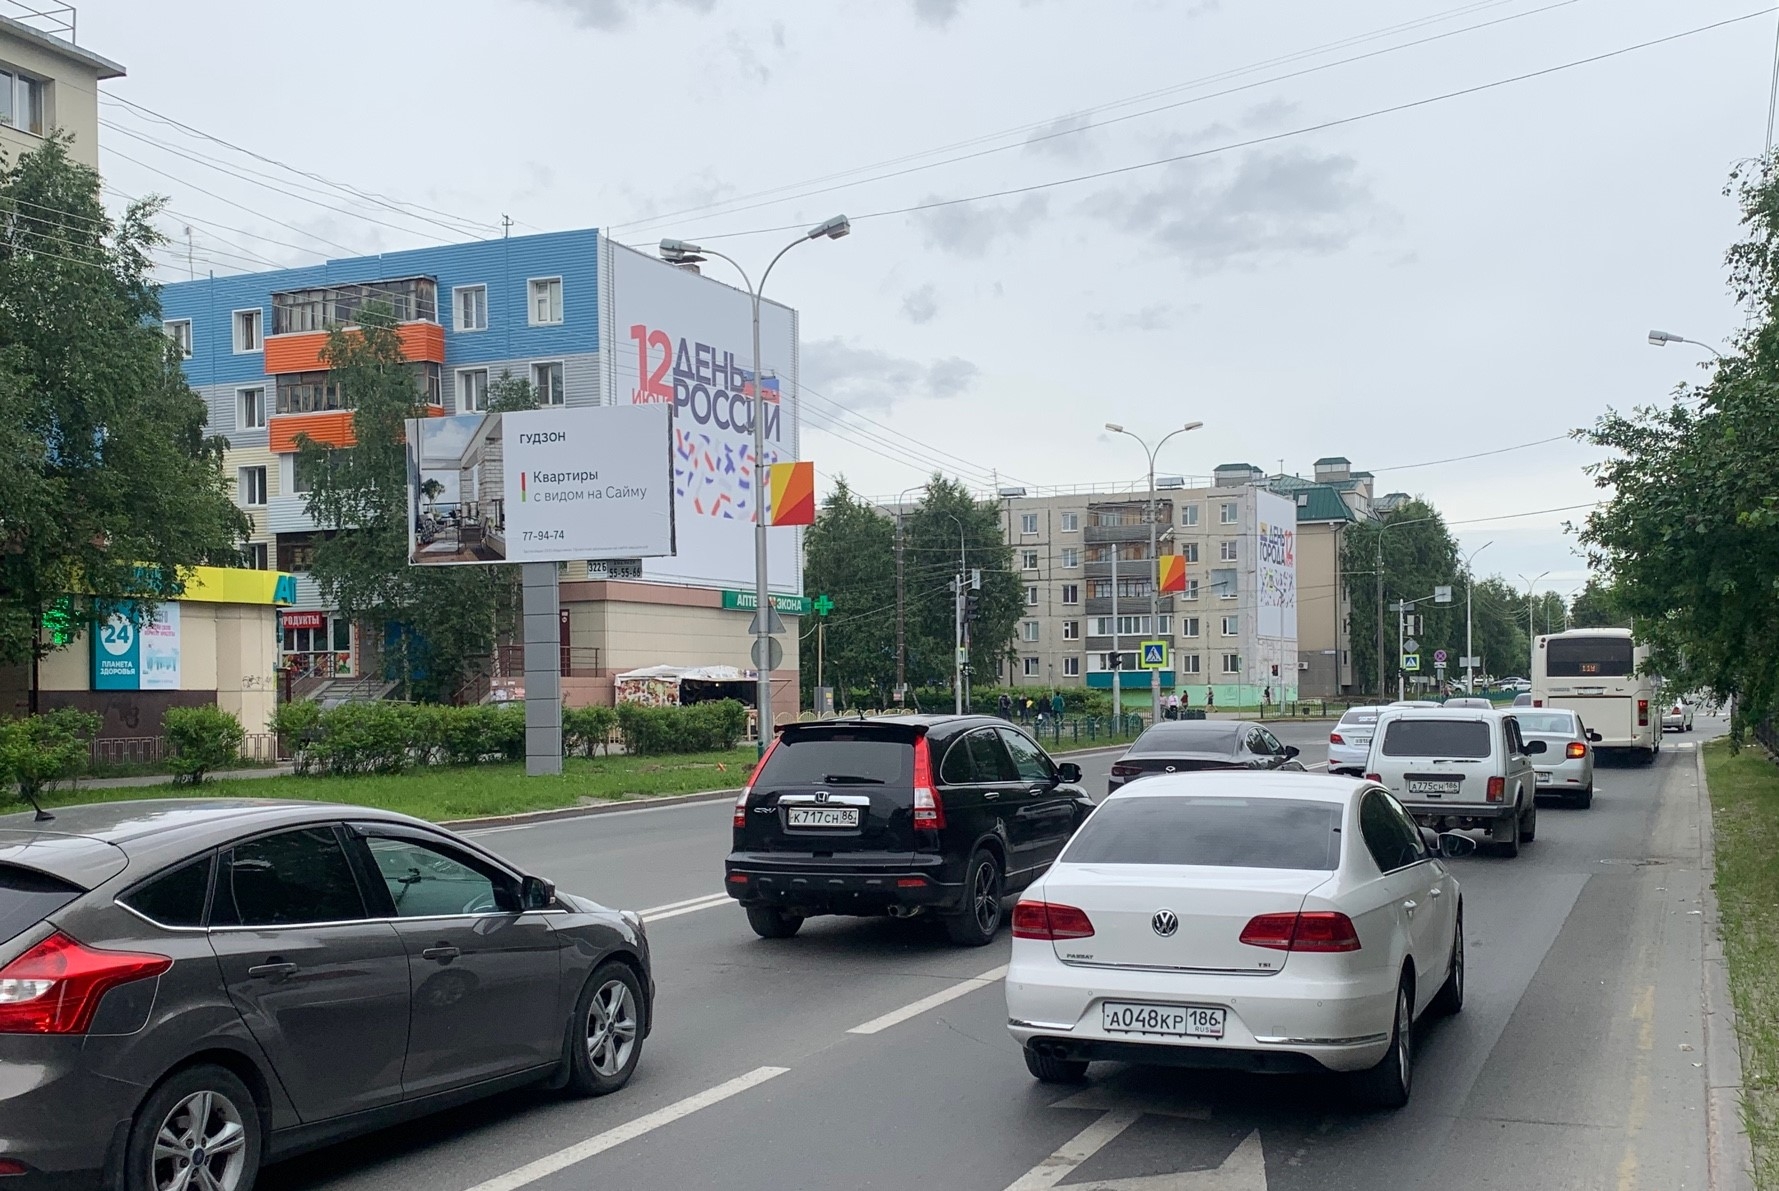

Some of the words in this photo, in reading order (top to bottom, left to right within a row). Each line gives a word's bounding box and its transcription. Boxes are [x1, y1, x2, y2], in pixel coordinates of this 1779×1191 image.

[631, 324, 674, 401] 12
[673, 337, 745, 392] ДЕНЬ
[519, 432, 566, 445] ГУДЗОН
[533, 470, 598, 485] Квартиры
[533, 492, 541, 502] с
[544, 490, 584, 503] видом
[588, 489, 602, 500] на
[605, 485, 648, 500] Сайму
[522, 530, 565, 541] 77-94-74
[1260, 541, 1285, 566] ГОРОДА
[609, 567, 641, 578] 55-55-66
[282, 615, 320, 626] РОДУКТЫ
[104, 624, 130, 643] 24
[101, 660, 133, 668] ПЛАНЕТА
[793, 811, 839, 823] К717СН
[842, 810, 854, 820] 86
[1109, 1008, 1184, 1030] А048КР
[1189, 1010, 1218, 1026] 186
